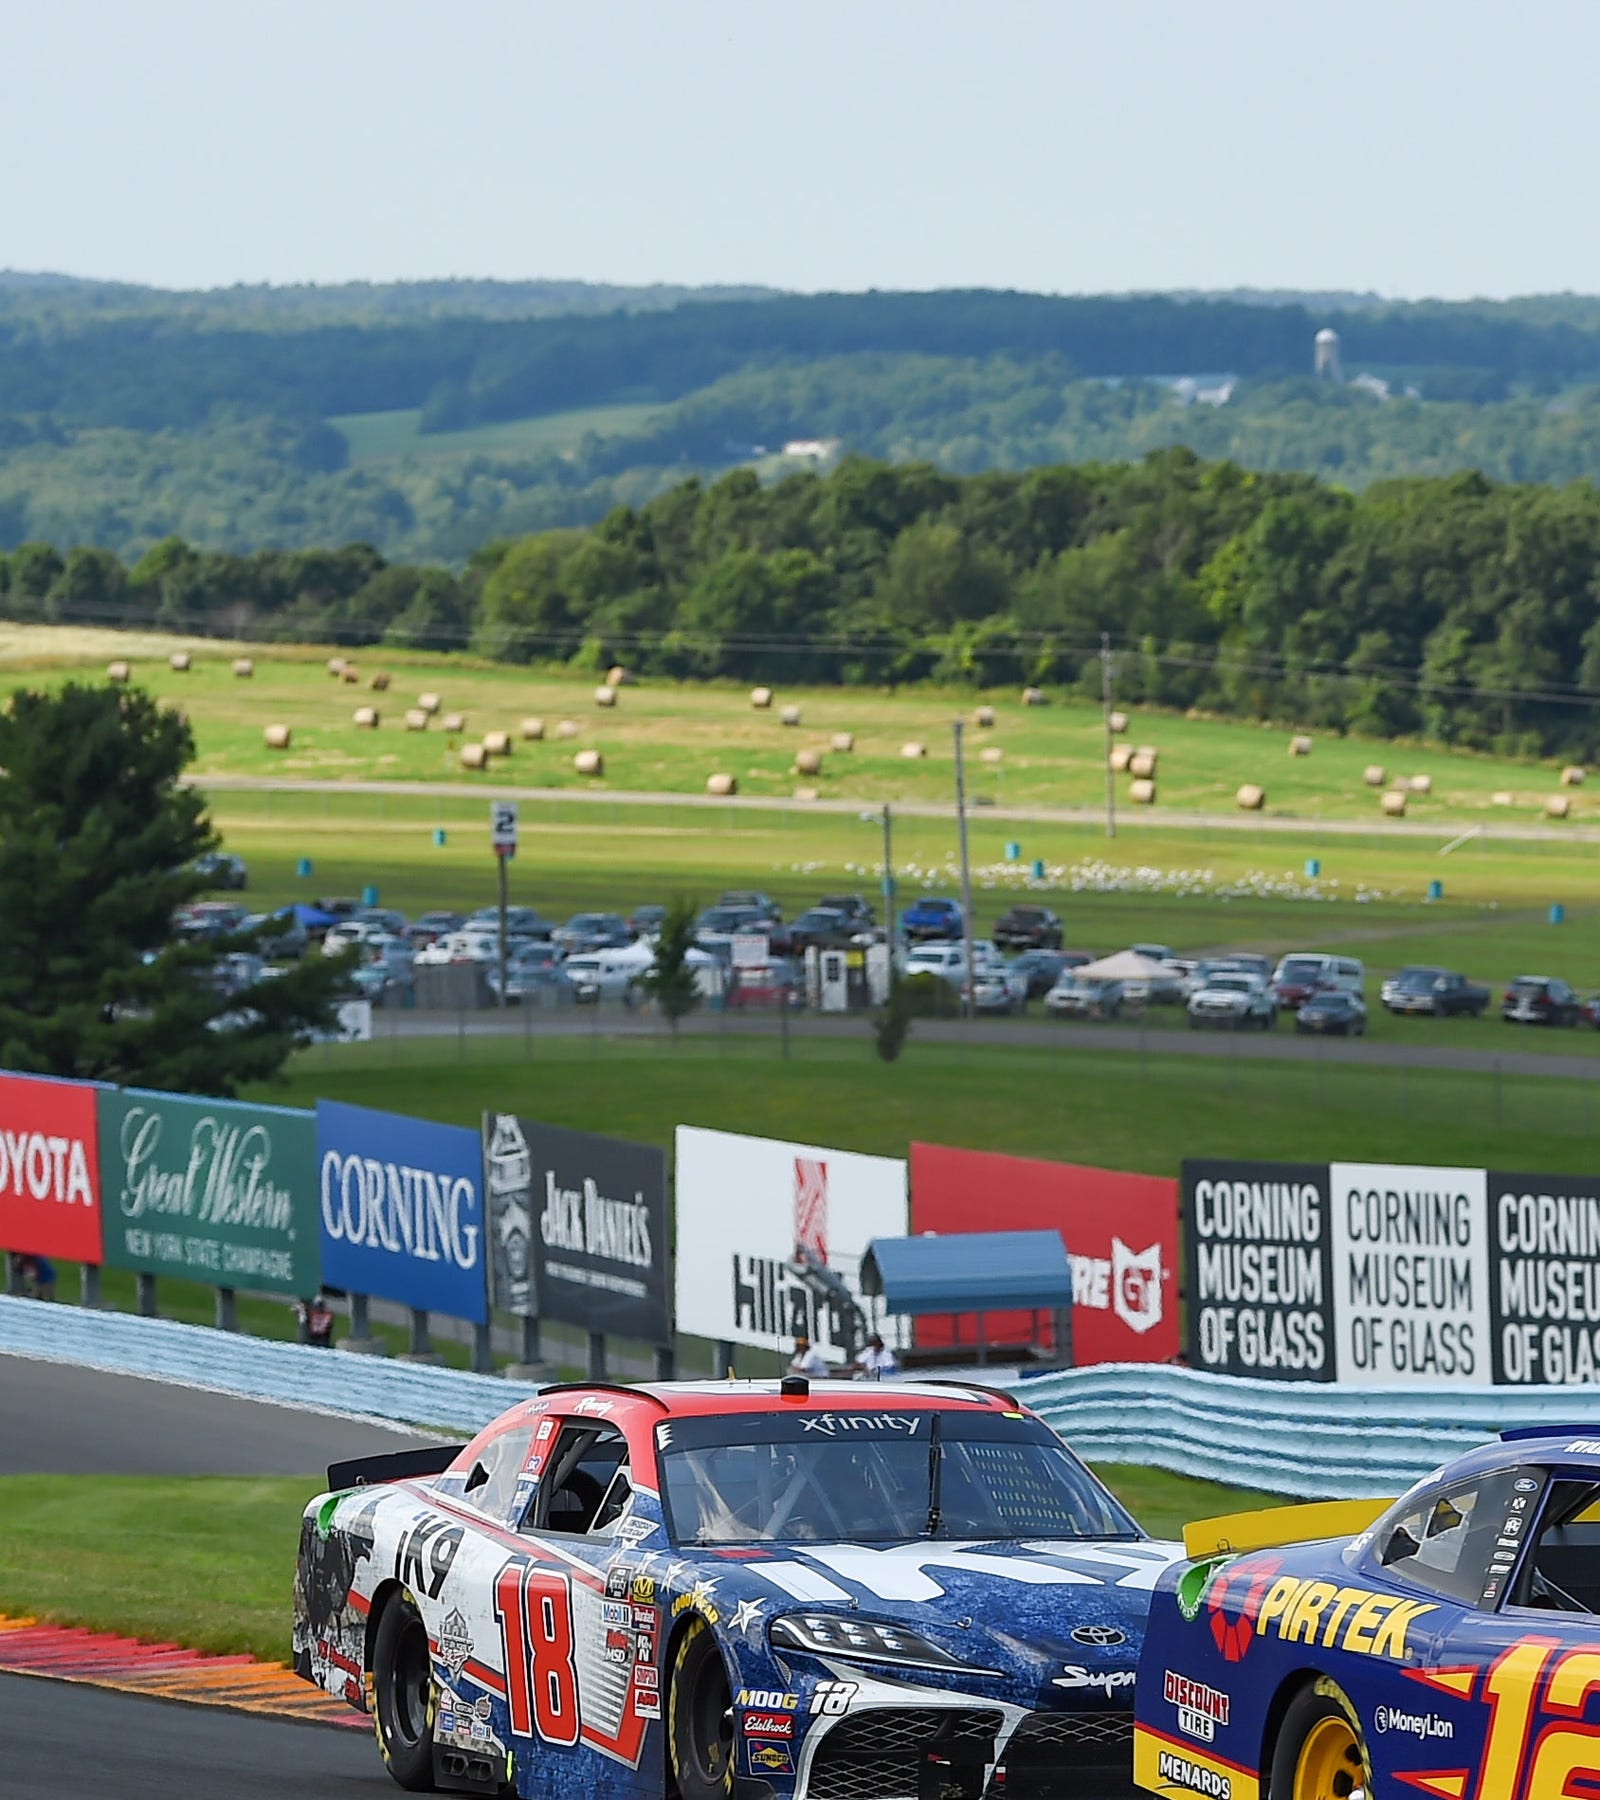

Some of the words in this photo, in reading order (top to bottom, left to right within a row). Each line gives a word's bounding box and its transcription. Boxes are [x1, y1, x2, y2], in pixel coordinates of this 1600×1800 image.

[120, 1106, 204, 1218] Great
[191, 1116, 292, 1231] Western
[320, 1150, 478, 1269] CORNING
[1195, 1179, 1321, 1243] CORNING
[1347, 1189, 1471, 1248] CORNING
[126, 1229, 151, 1257] NEW
[154, 1232, 183, 1262] YORK
[184, 1237, 222, 1270] STATE
[1198, 1244, 1323, 1307] MUSEUM
[1349, 1253, 1473, 1312] MUSEUM
[1199, 1306, 1238, 1367] OF
[1238, 1309, 1325, 1370] GLASS
[1352, 1316, 1383, 1371] OF
[1386, 1319, 1476, 1377] GLASS
[1502, 1322, 1541, 1383] OF
[799, 1413, 920, 1435] xfinity
[1257, 1576, 1442, 1660] PIRTEK
[495, 1556, 580, 1746] 18
[605, 1648, 627, 1663] MSD
[735, 1690, 800, 1710] MOOG
[744, 1715, 793, 1735] Edelbrock
[808, 1680, 860, 1716] 18
[1164, 1669, 1230, 1726] DISCOUNT
[1182, 1710, 1211, 1737] TIRE
[1388, 1707, 1454, 1740] MoneyLion
[751, 1752, 790, 1763] SUNOCO
[1159, 1751, 1232, 1799] MENARDS
